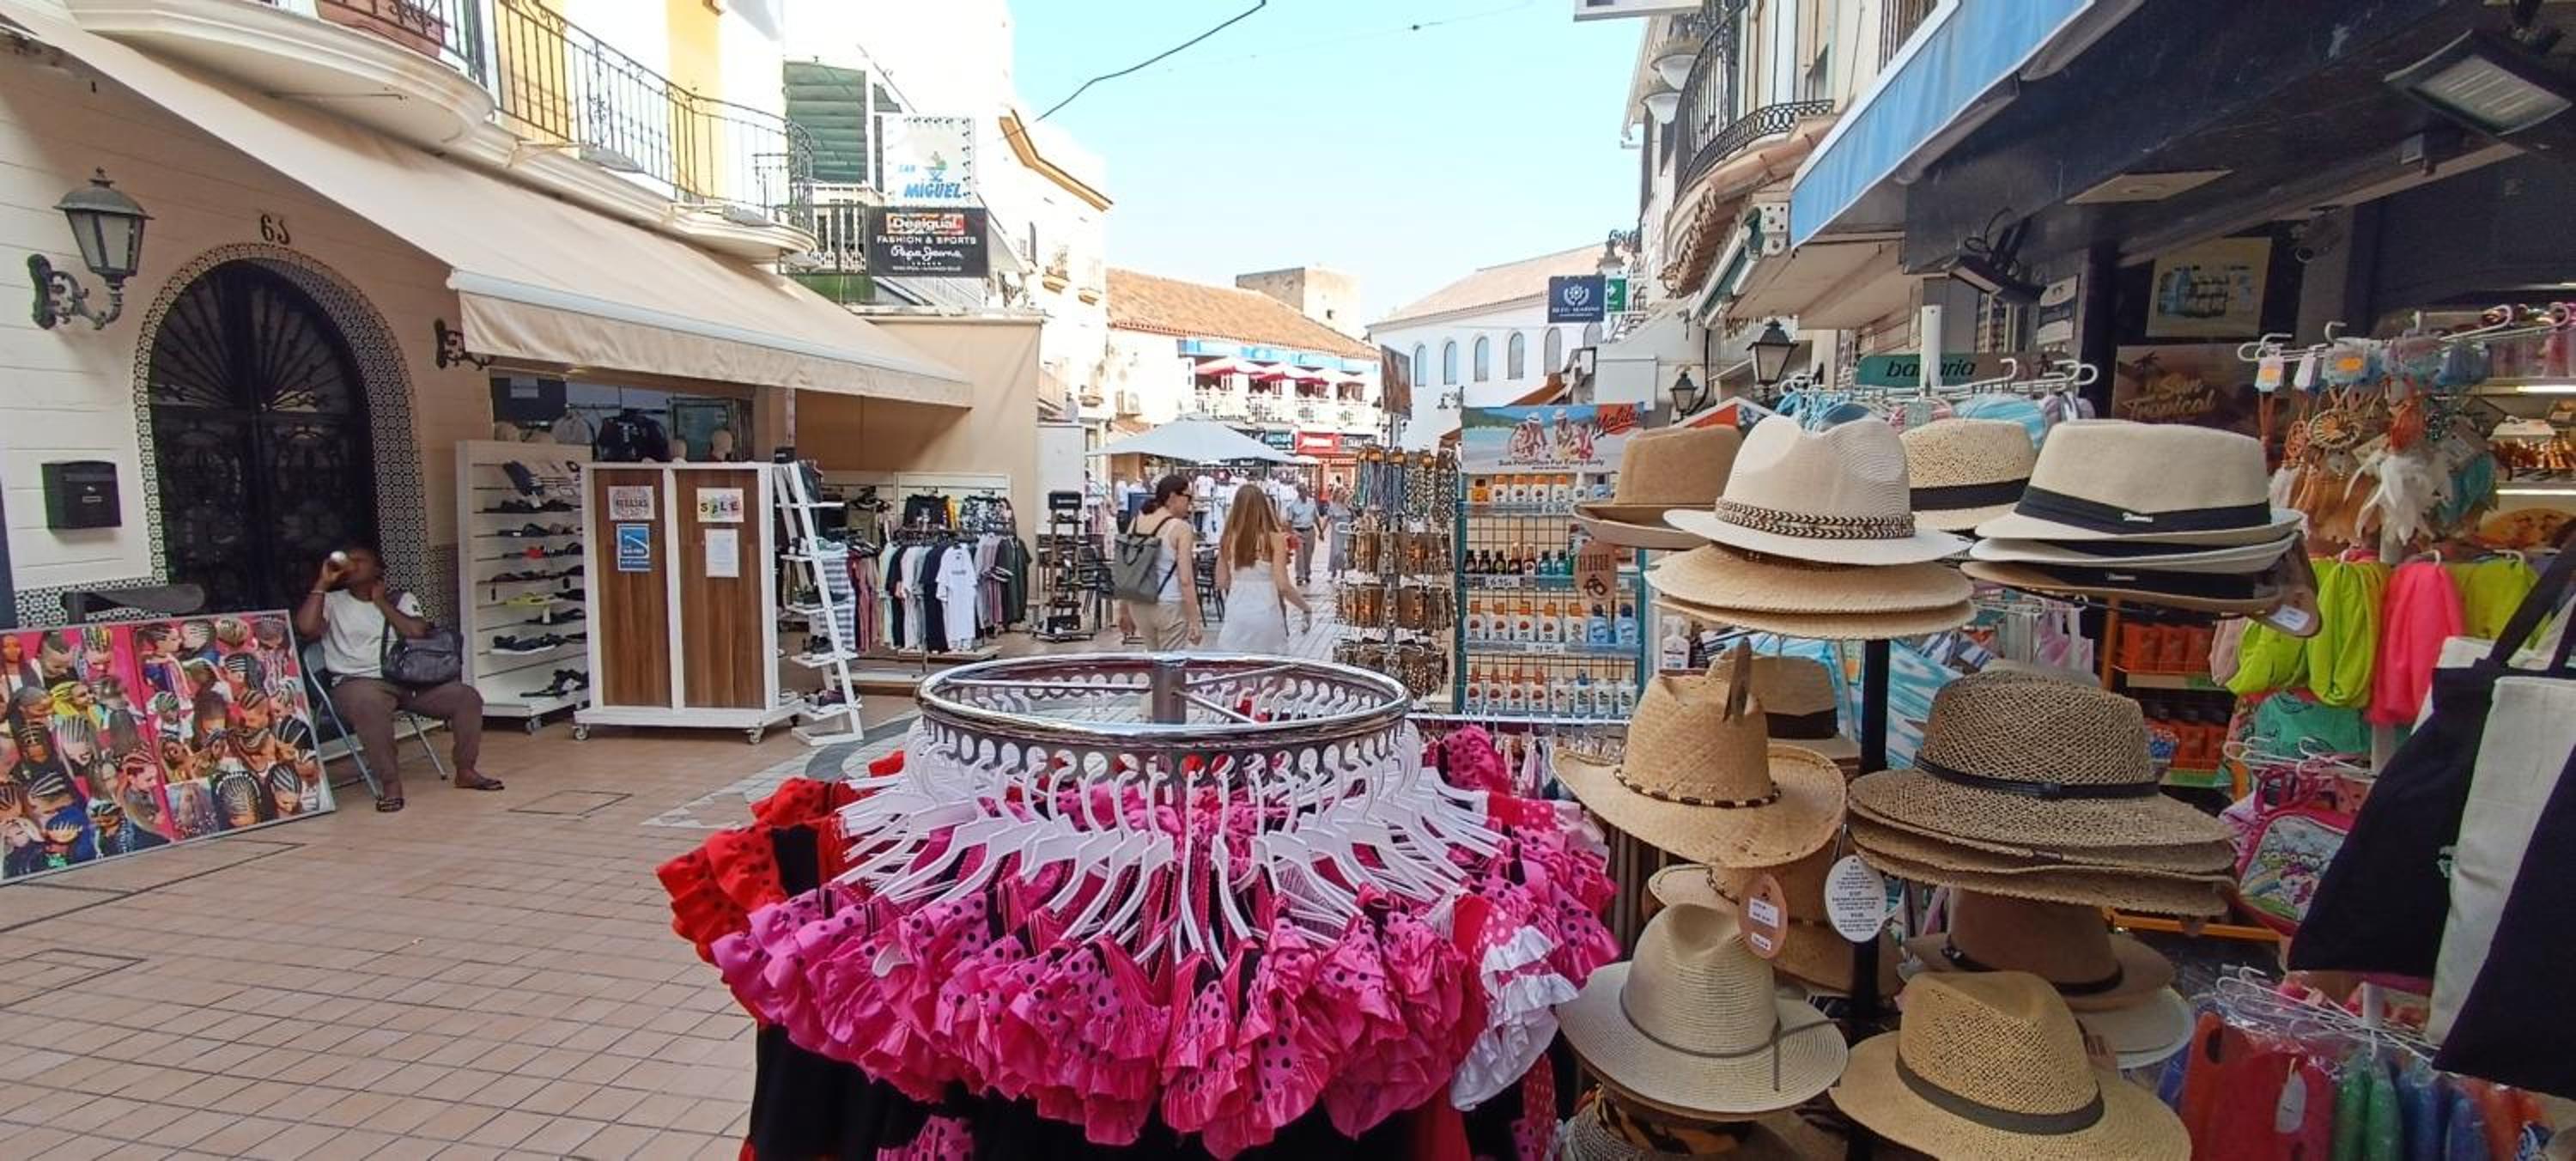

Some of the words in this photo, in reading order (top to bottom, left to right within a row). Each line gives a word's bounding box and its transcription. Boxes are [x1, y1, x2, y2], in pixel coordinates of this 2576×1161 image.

[877, 234, 922, 245] FASHION
[925, 235, 933, 244] &
[936, 235, 976, 245] SPORTS
[890, 245, 921, 260] Pepe
